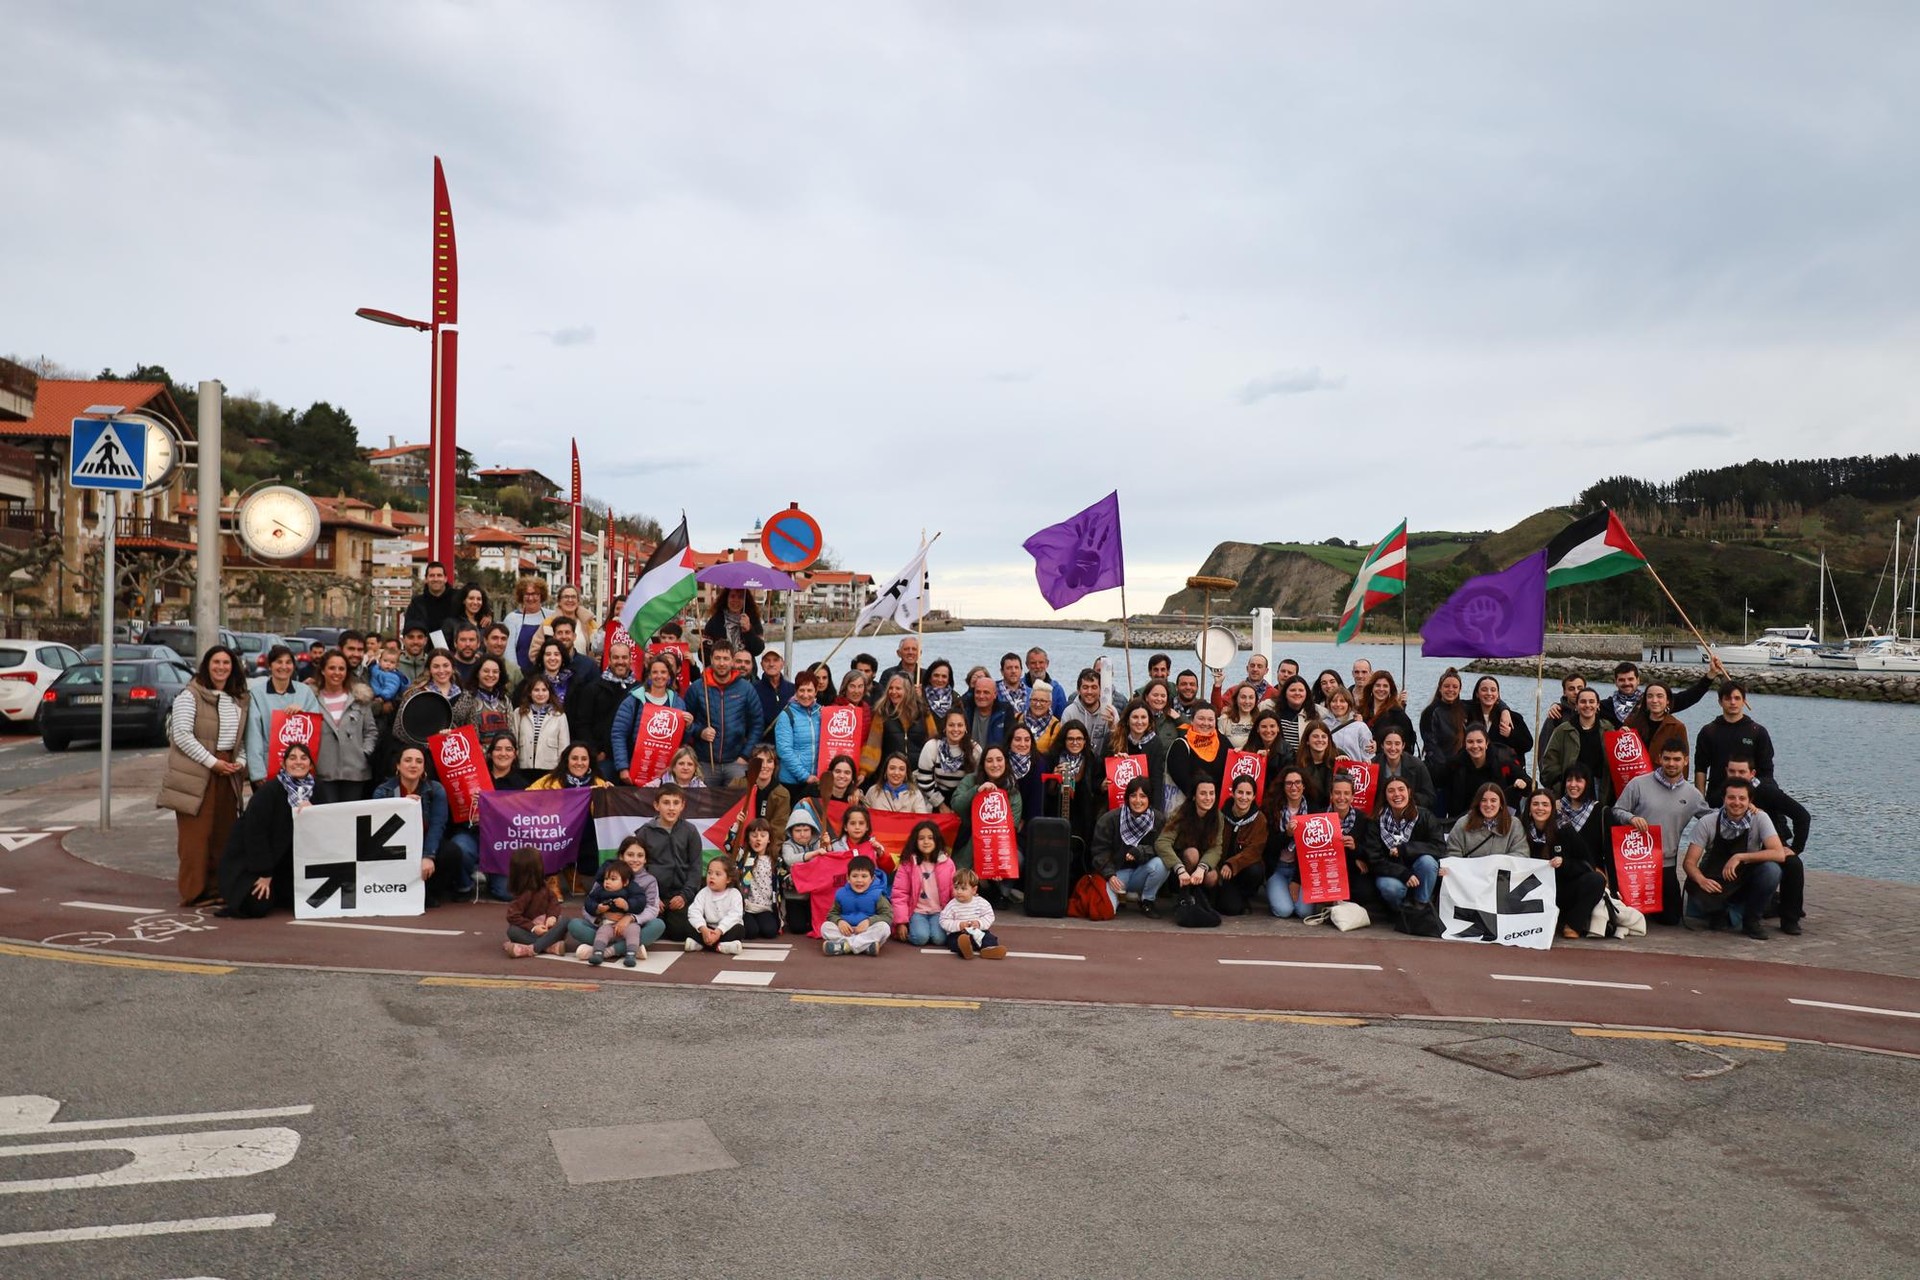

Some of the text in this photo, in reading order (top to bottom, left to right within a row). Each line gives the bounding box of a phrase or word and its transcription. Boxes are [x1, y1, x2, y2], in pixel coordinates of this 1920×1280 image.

[984, 801, 1001, 813] PEN
[512, 813, 560, 826] denon
[1305, 819, 1321, 829] INDE
[507, 825, 567, 839] bizitzak
[1307, 824, 1324, 837] PEN
[1625, 830, 1641, 841] INDE
[1626, 837, 1644, 849] PEN
[363, 882, 407, 894] etxera
[1503, 926, 1543, 941] etxera
